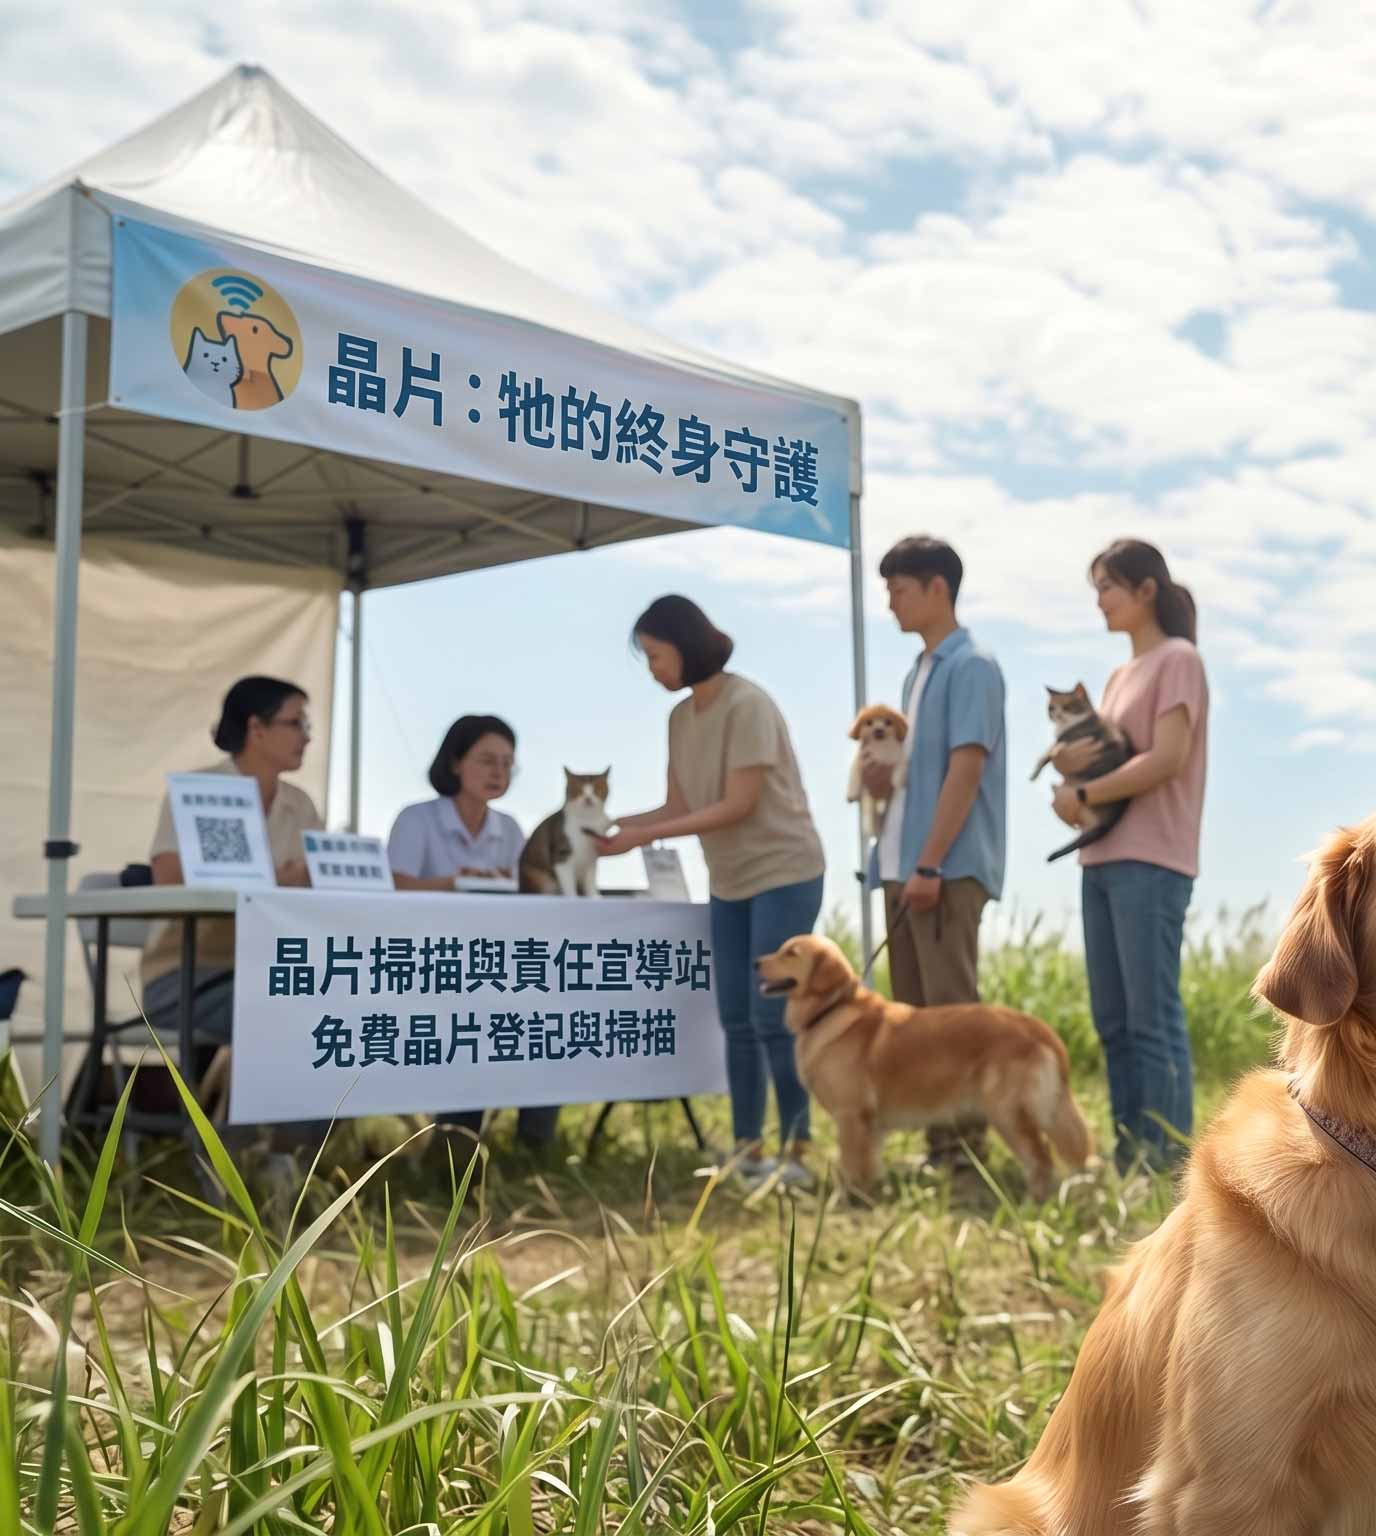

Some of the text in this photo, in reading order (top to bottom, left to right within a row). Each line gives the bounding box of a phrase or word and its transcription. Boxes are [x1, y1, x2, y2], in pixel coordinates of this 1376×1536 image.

[328, 333, 819, 506] 晶片：牠的終身守護
[268, 936, 711, 996] 晶片掃描與責任宣導站
[311, 1009, 677, 1069] 免費晶片登記與掃描
